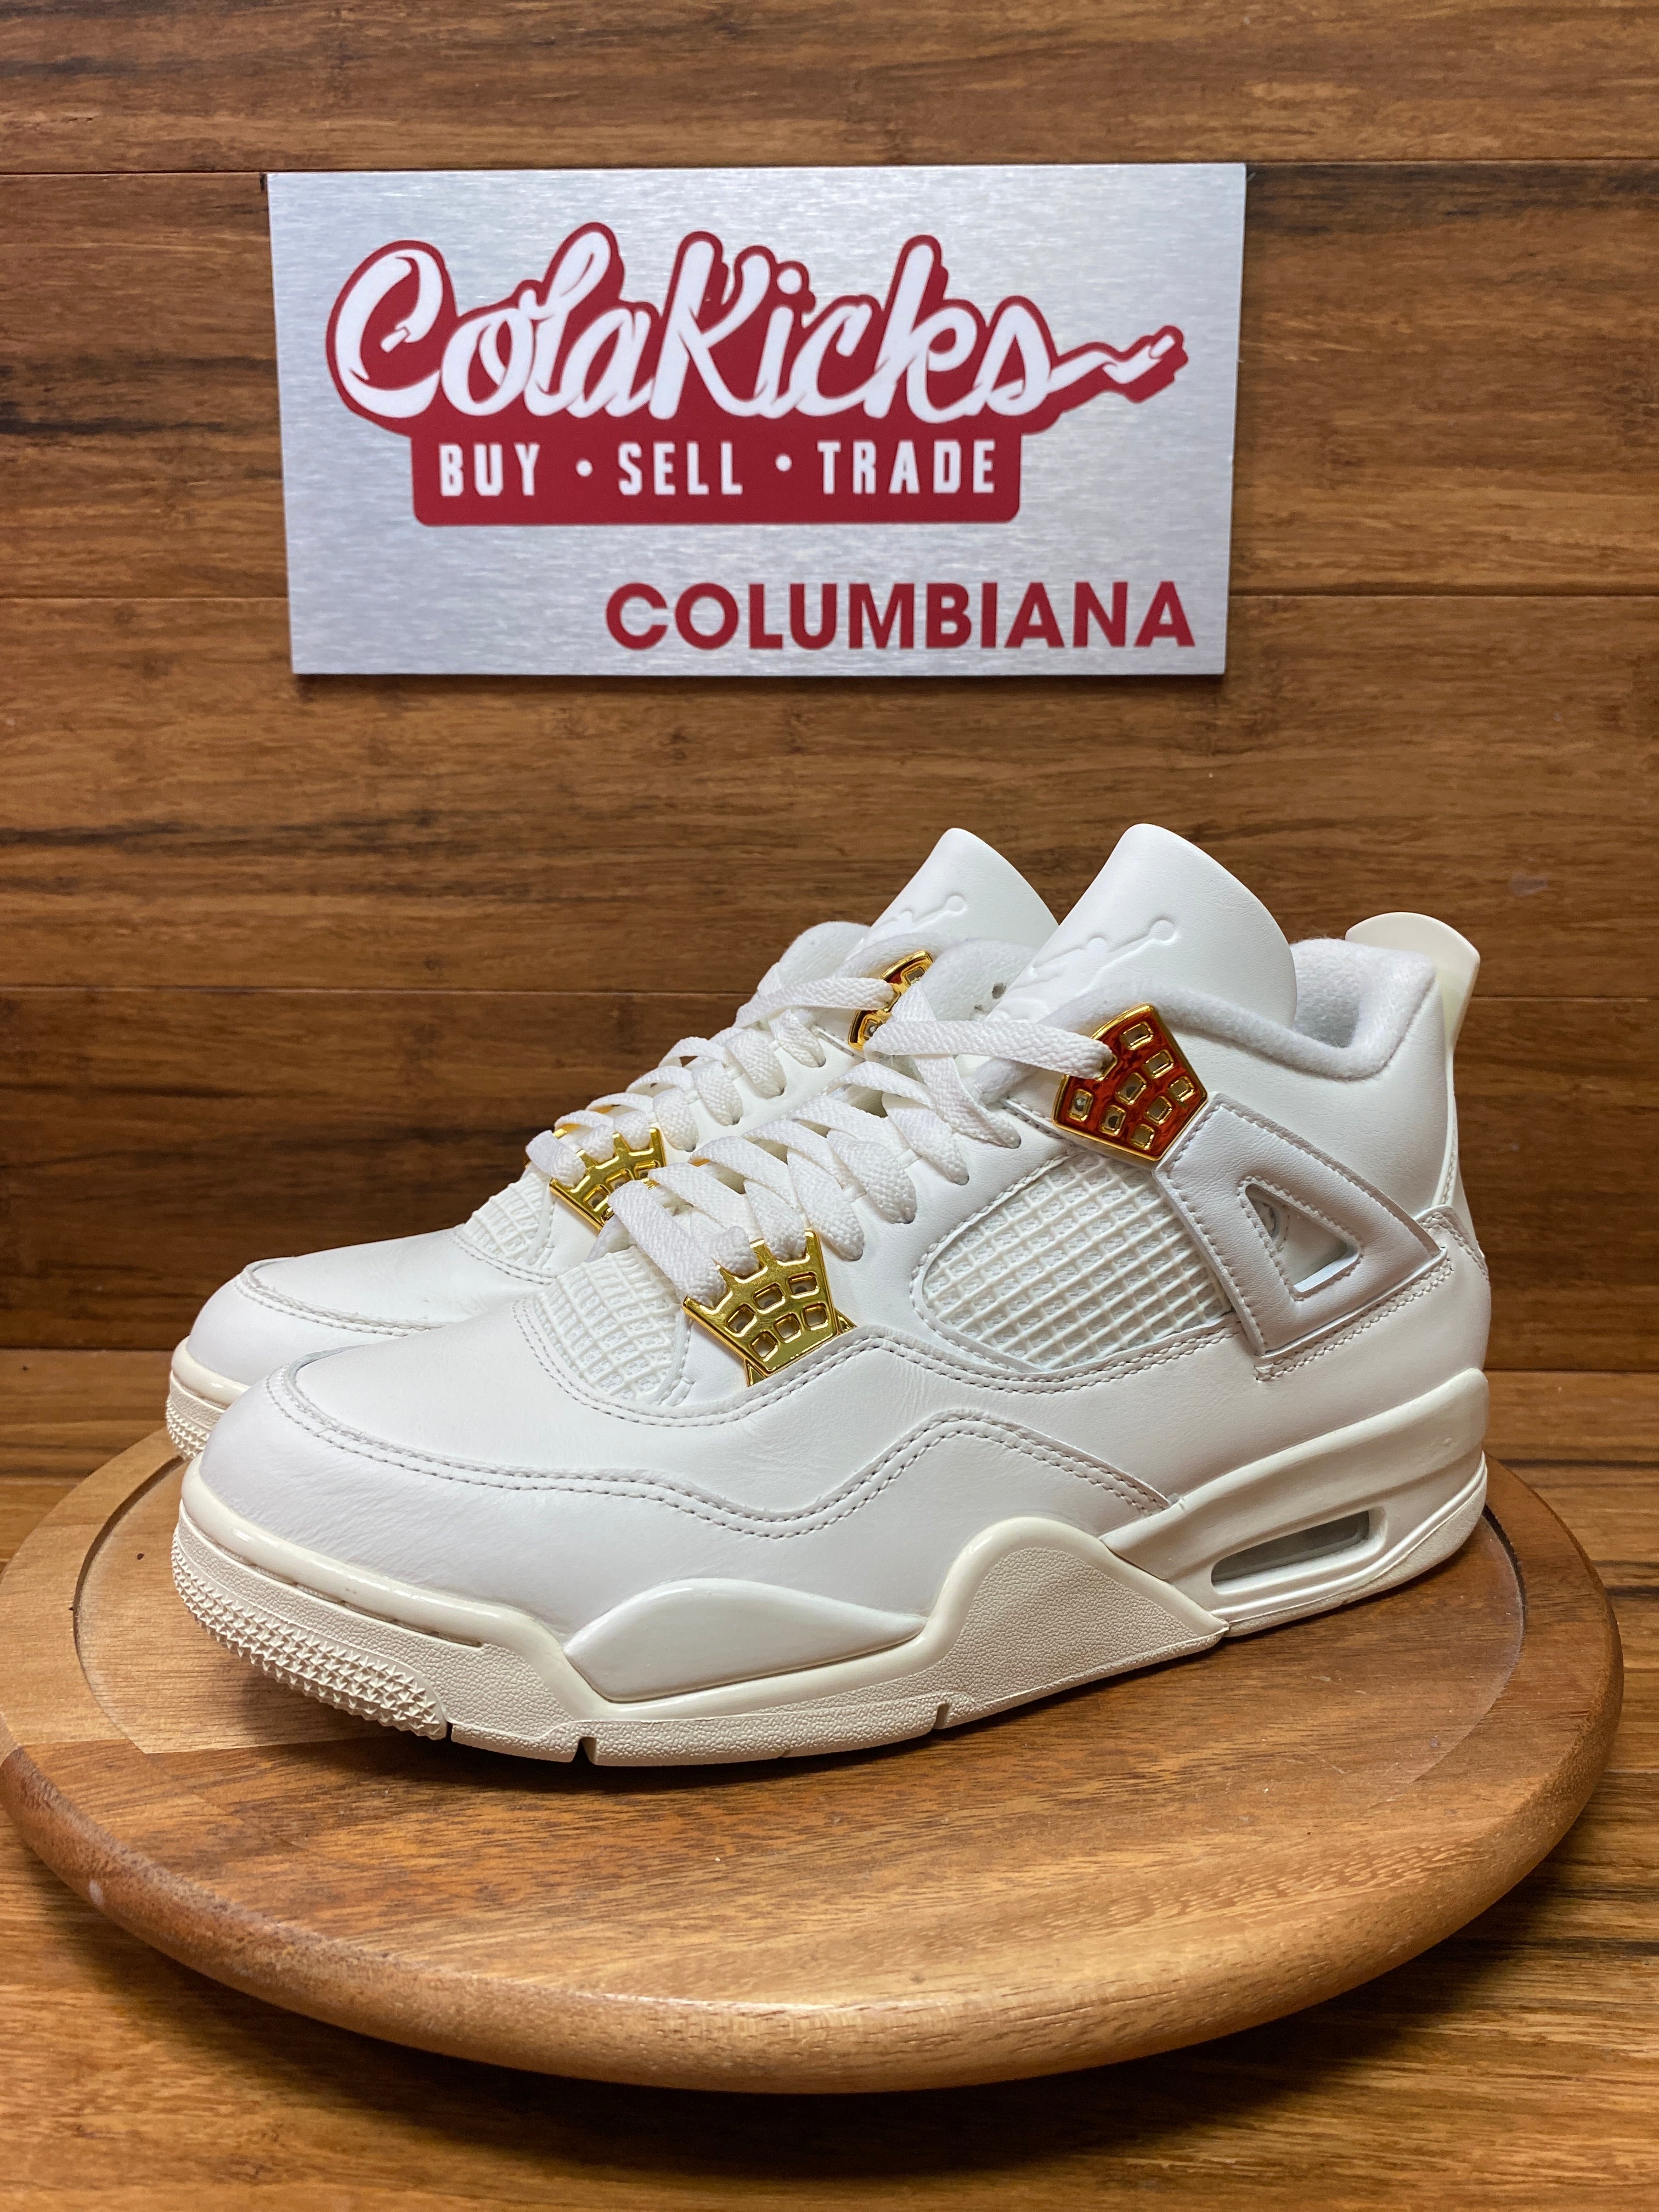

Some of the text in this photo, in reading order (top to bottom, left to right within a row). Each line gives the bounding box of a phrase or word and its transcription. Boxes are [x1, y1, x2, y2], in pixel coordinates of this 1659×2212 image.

[334, 230, 1175, 424] ColaKicks
[439, 440, 996, 497] BUY SELL TRADE
[605, 580, 1195, 650] COLUMBIANA
